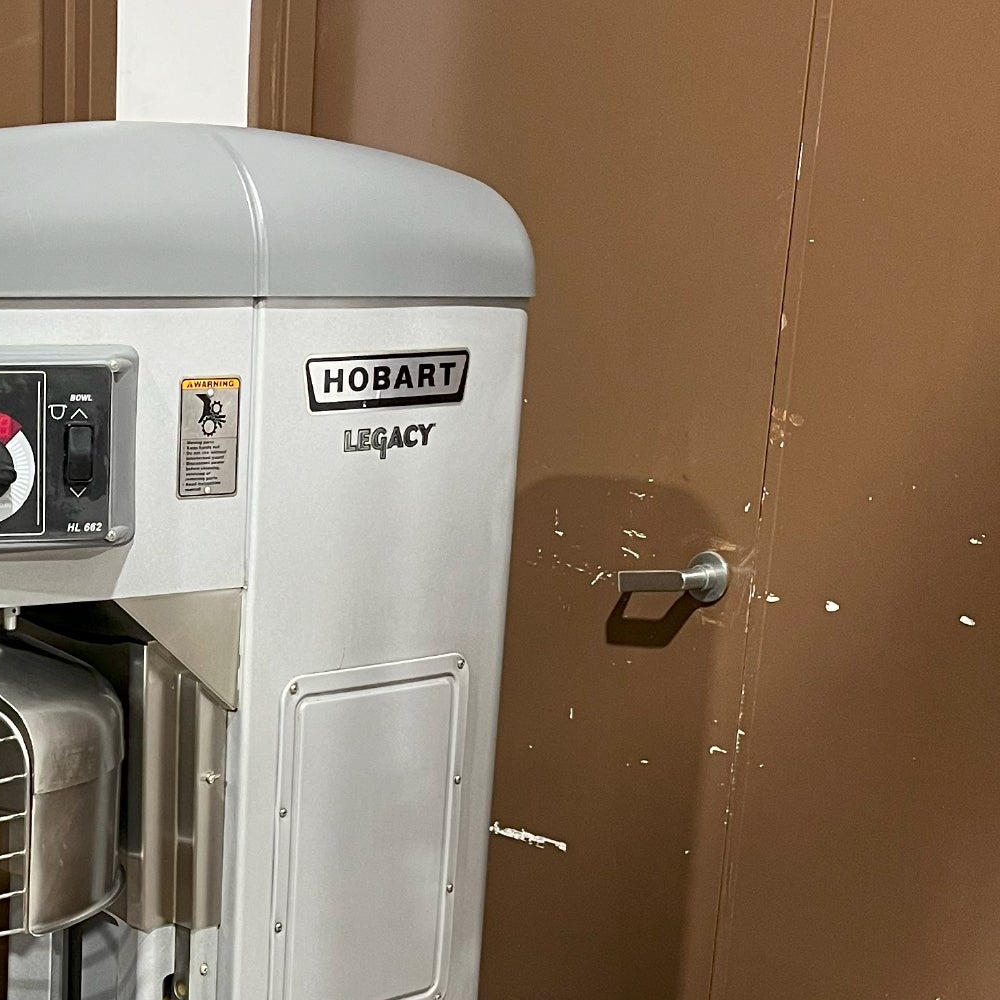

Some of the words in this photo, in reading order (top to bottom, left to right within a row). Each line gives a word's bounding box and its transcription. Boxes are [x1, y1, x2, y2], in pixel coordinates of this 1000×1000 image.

[323, 361, 457, 394] HOBART
[194, 380, 235, 388] WARNING
[69, 394, 93, 402] BOWL
[343, 422, 435, 459] LEGACY
[67, 522, 81, 532] HL
[83, 522, 103, 532] 662
